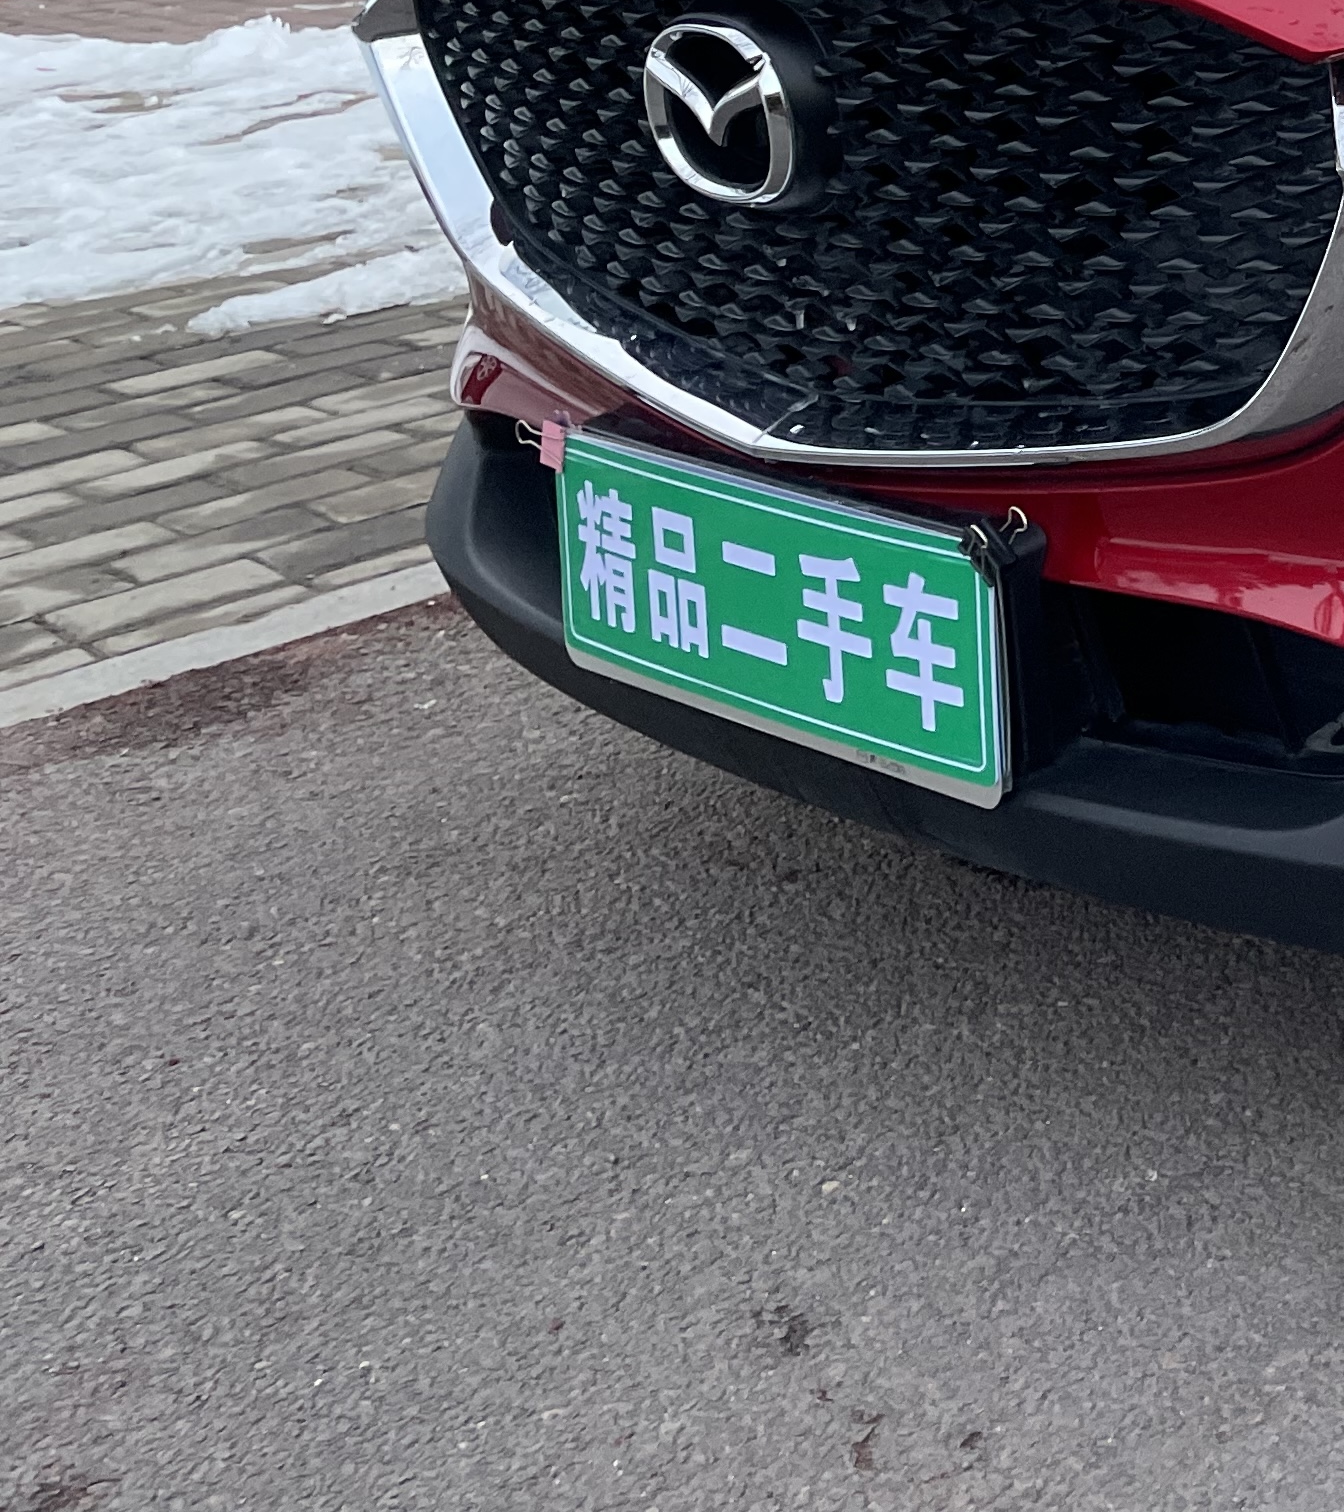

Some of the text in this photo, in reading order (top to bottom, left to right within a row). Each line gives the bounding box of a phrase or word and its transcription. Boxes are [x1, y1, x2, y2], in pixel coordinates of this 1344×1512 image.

[576, 480, 965, 733] 精品二手车
